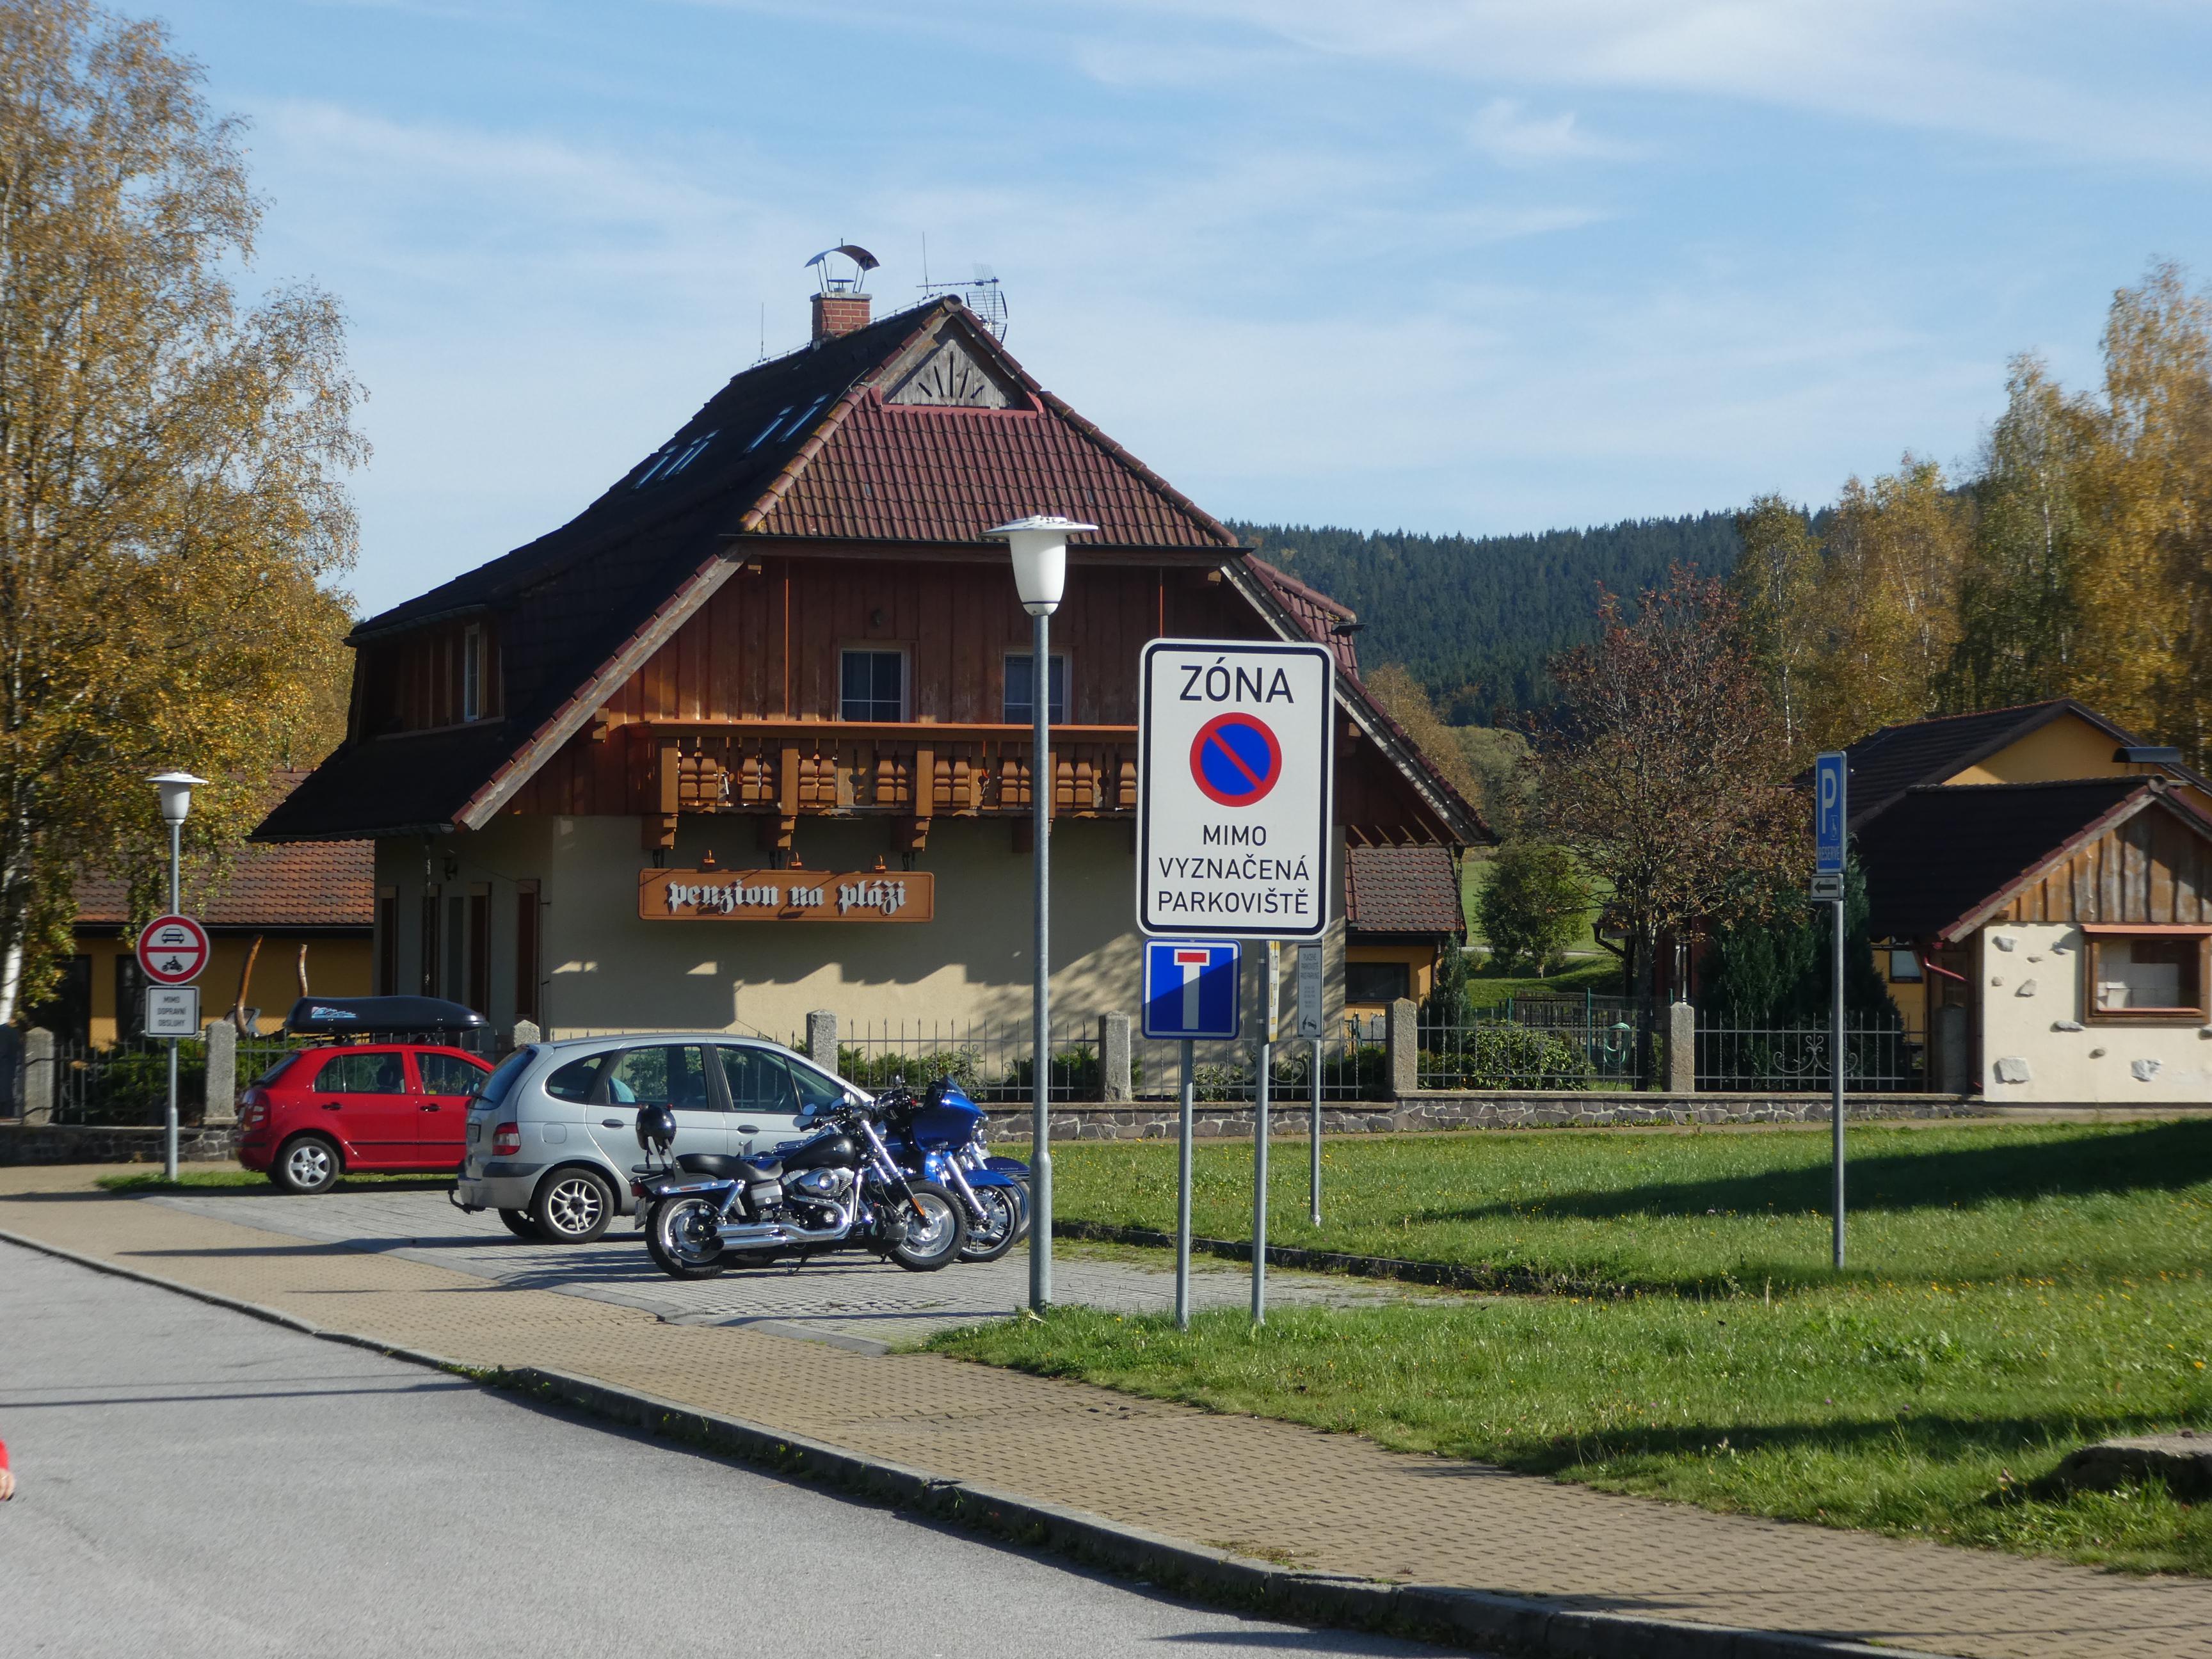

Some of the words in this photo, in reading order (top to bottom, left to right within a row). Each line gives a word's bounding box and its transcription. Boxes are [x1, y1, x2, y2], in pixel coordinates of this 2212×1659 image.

[1179, 657, 1294, 704] ZÓNA
[1822, 768, 1837, 835] P
[1203, 824, 1267, 846] MIMO
[1158, 853, 1310, 881] VYZNAČENÁ
[669, 880, 779, 915] penzion
[789, 885, 825, 907] na
[840, 880, 907, 915] pláži
[1158, 888, 1309, 915] PARKOVIŠTĚ
[157, 1006, 187, 1015] DOPRAVNÍ
